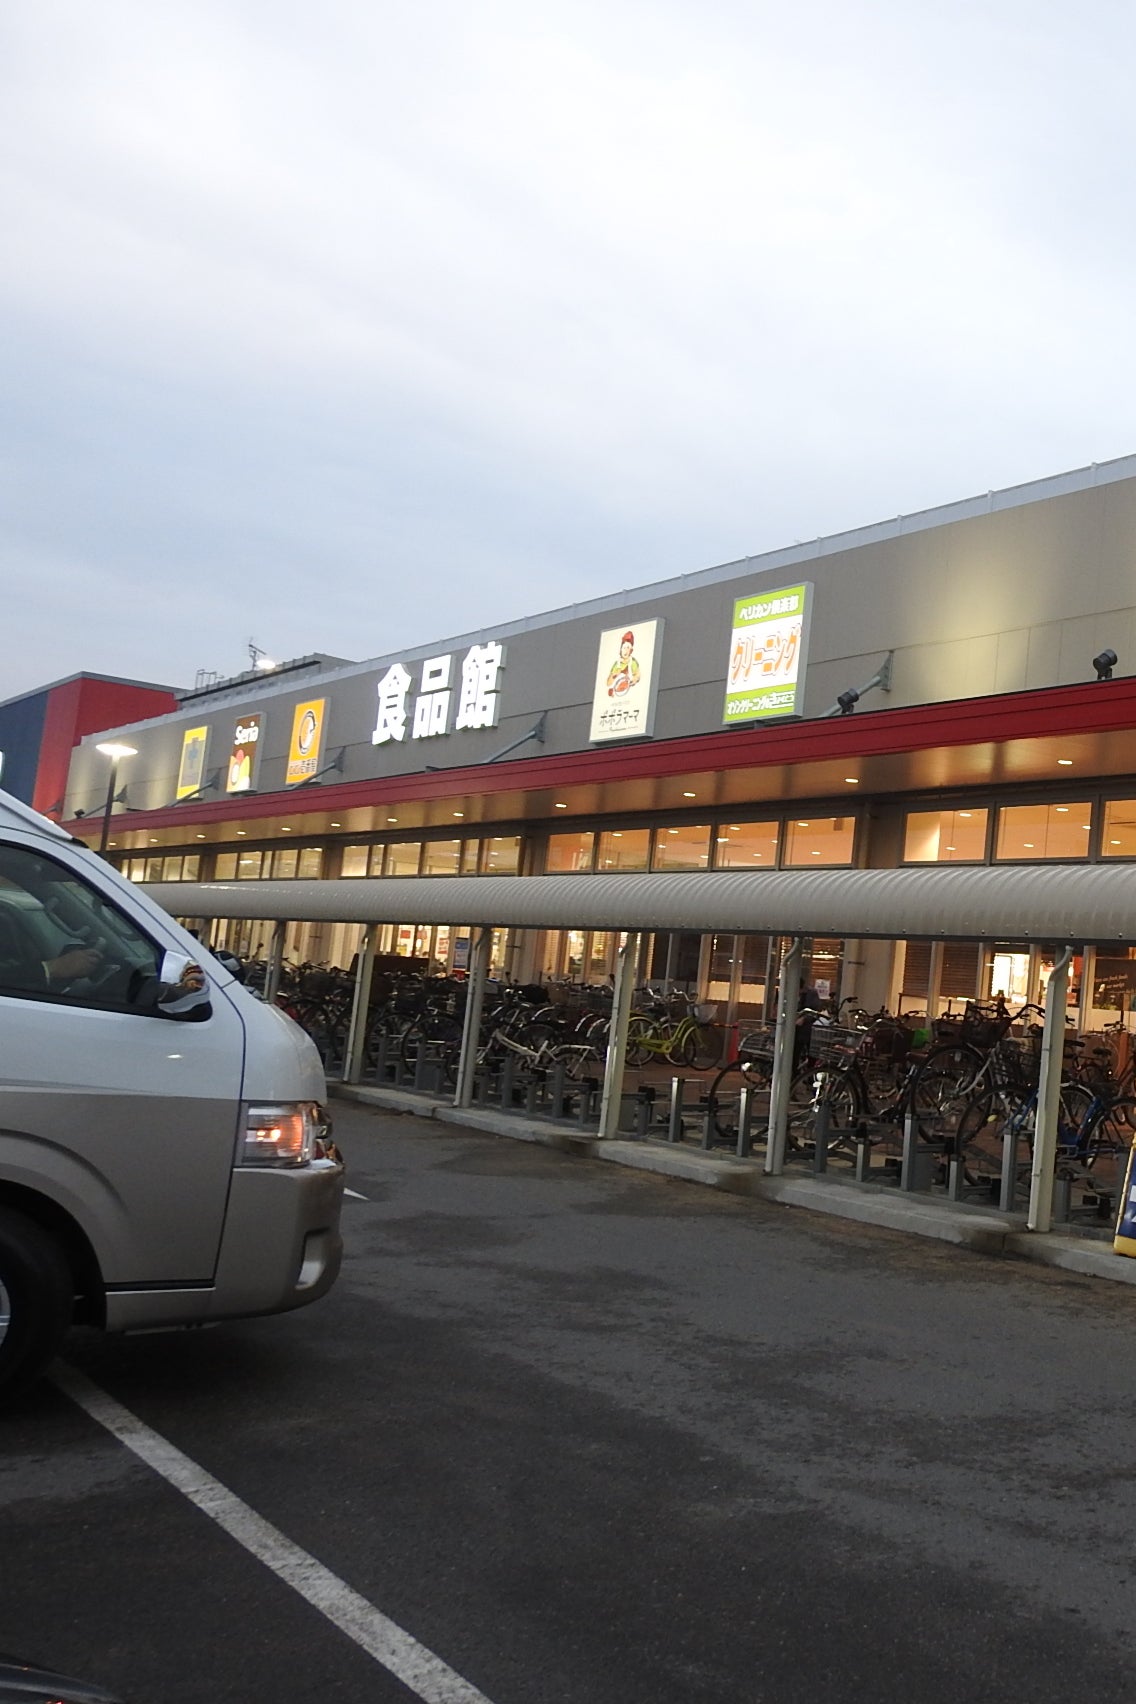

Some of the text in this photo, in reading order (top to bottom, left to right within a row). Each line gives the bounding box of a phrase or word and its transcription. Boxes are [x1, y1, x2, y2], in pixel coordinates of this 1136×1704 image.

[730, 623, 802, 685] クリーニング
[372, 641, 505, 745] 食品館
[234, 721, 259, 745] Seria
[599, 709, 640, 727] ポポラマーマ
